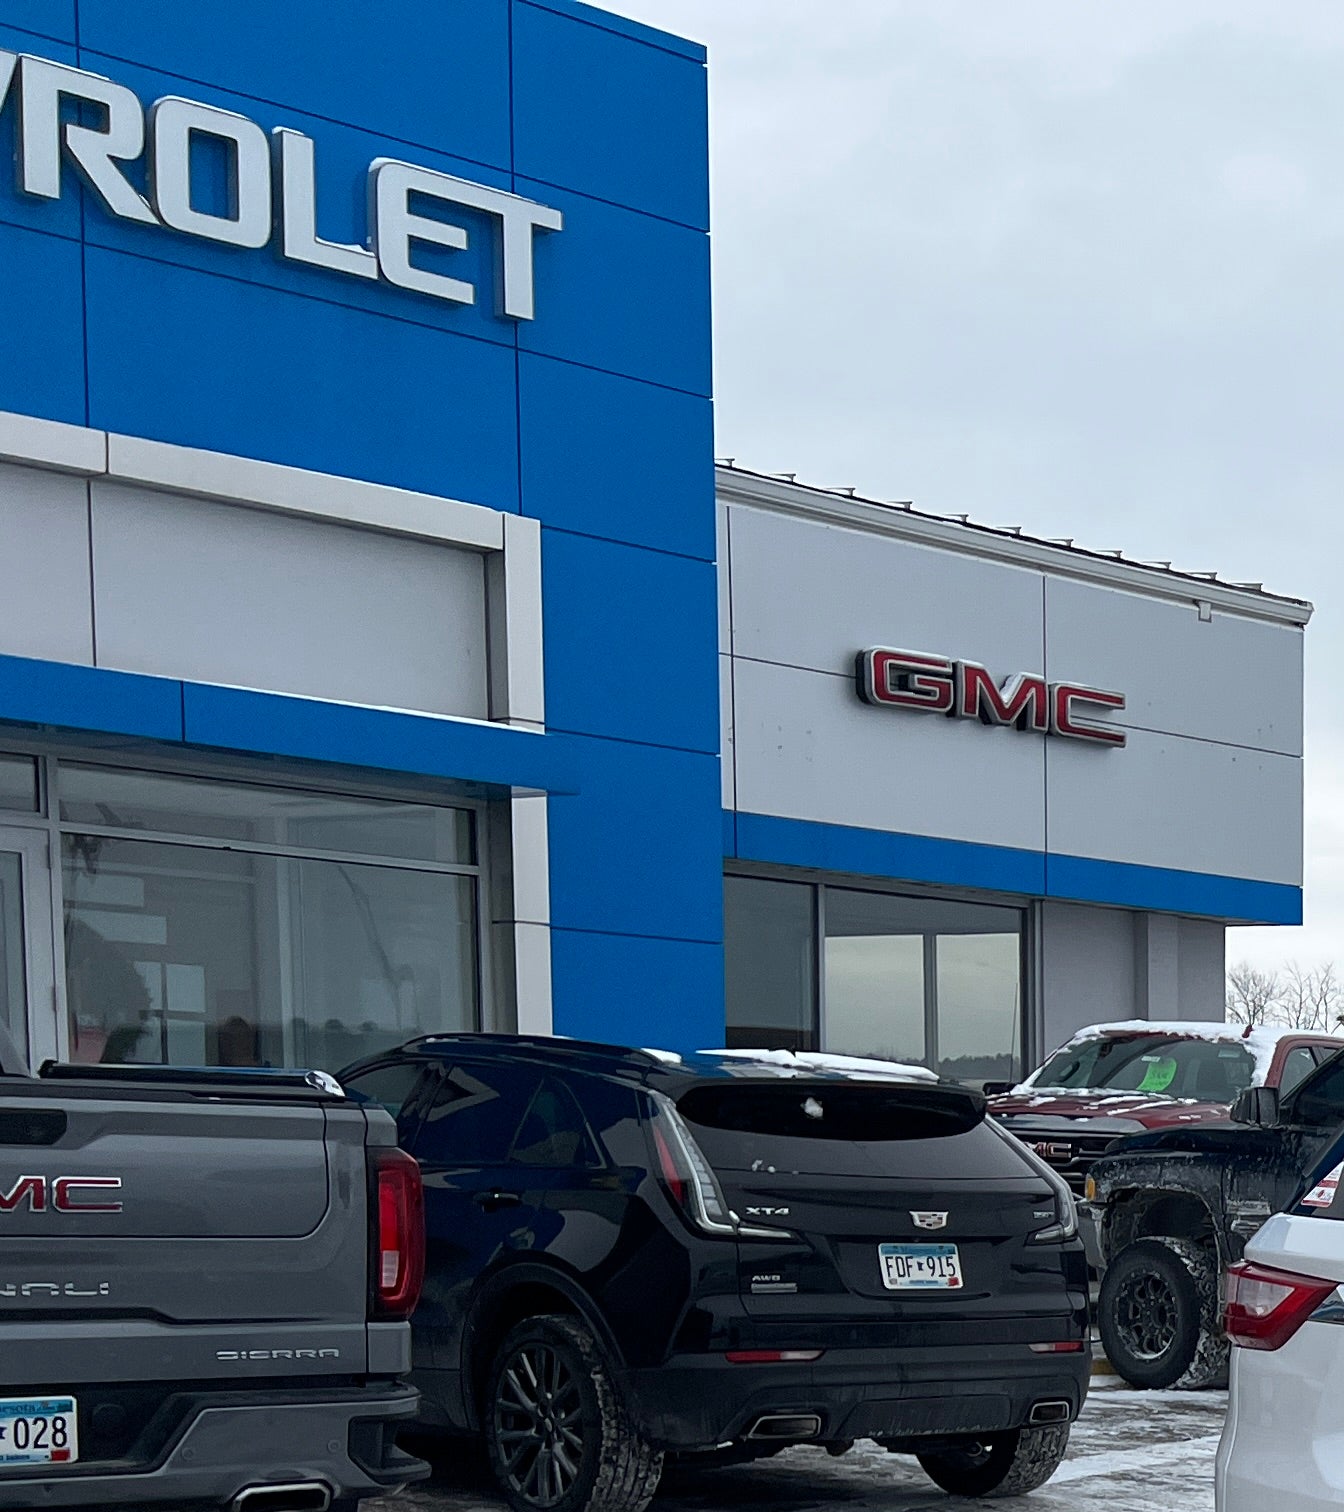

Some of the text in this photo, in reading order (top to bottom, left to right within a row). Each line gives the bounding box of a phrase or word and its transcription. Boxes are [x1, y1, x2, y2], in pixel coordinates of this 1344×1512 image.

[0, 50, 563, 321] ROLET
[856, 645, 1126, 748] GMC
[745, 1207, 789, 1216] XT4
[885, 1255, 956, 1278] FDF 915
[216, 1348, 340, 1360] SIERRA
[13, 1415, 68, 1450] 028
